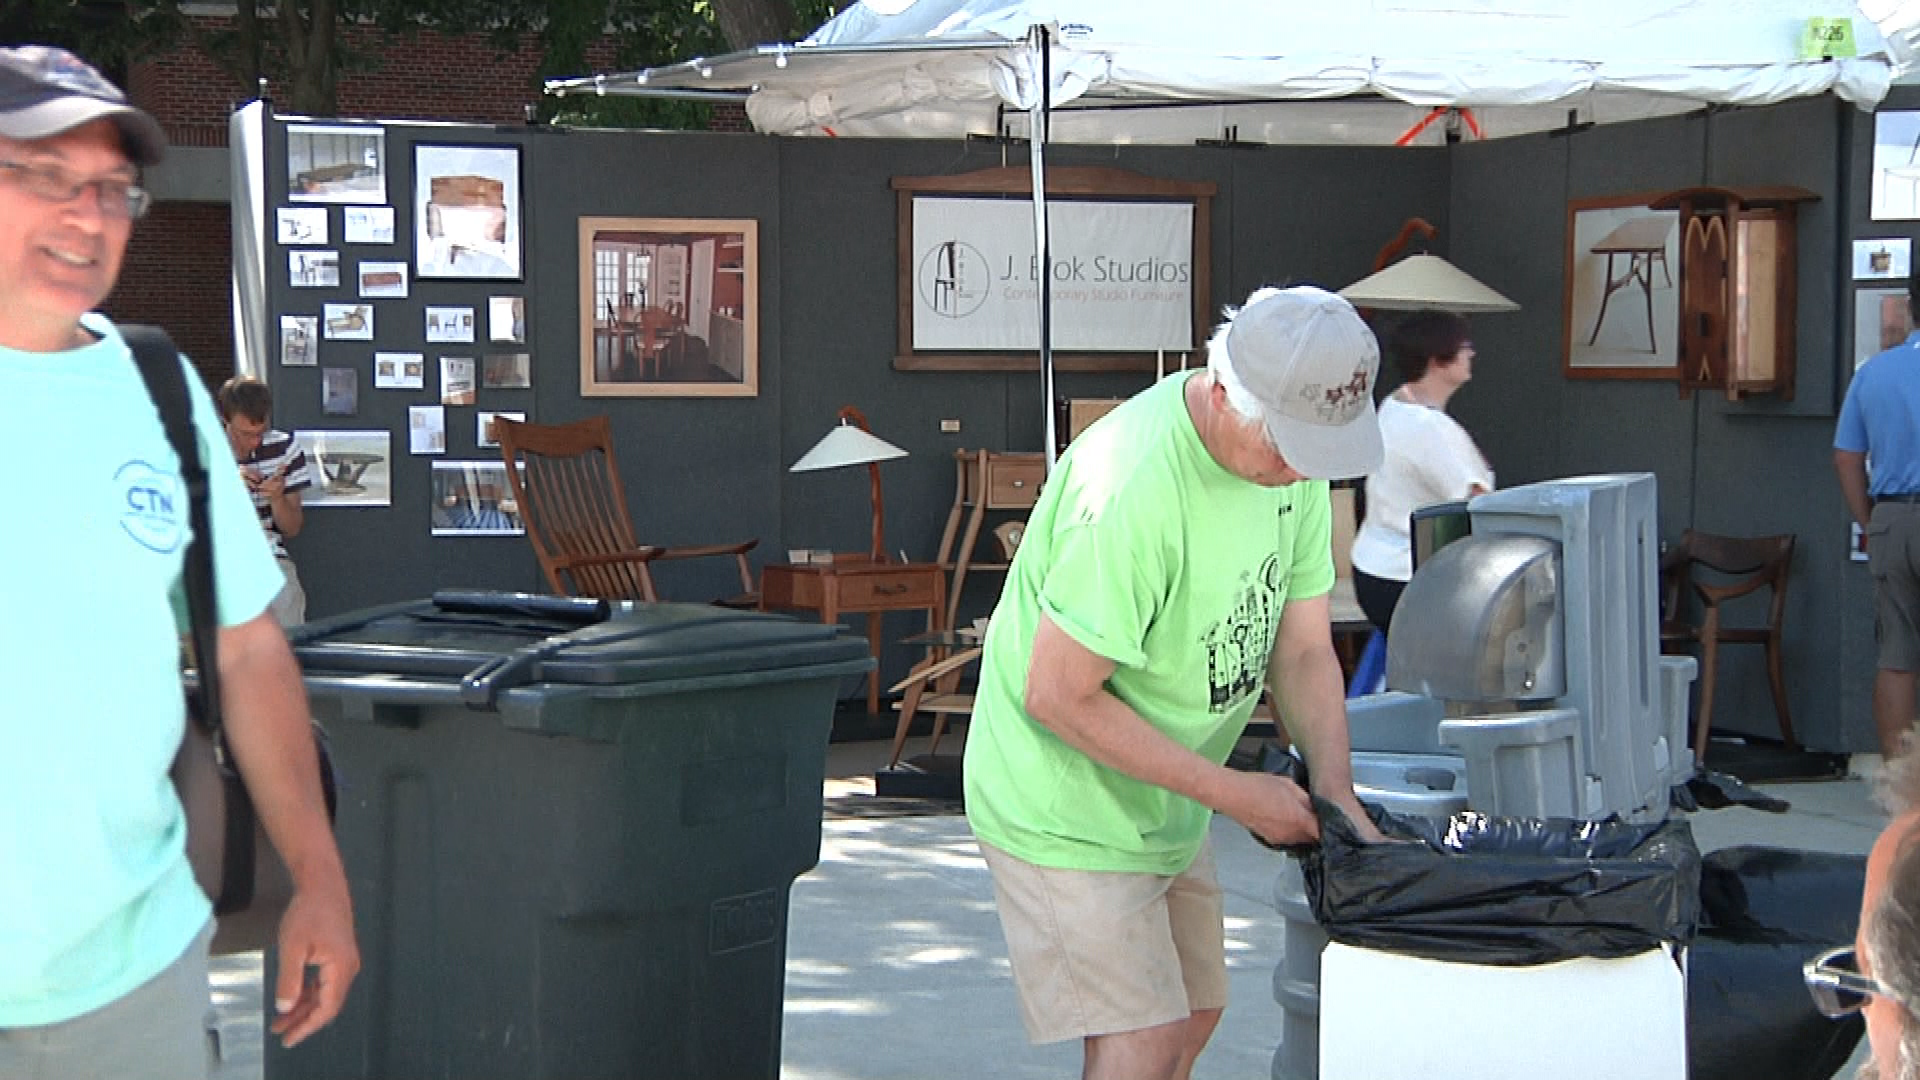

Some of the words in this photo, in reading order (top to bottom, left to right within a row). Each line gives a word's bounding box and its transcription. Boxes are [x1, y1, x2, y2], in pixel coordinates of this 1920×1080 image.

[1000, 255, 1019, 281] J.
[1093, 255, 1189, 283] Studios
[1091, 287, 1128, 301] Studio
[127, 485, 174, 513] CTN
